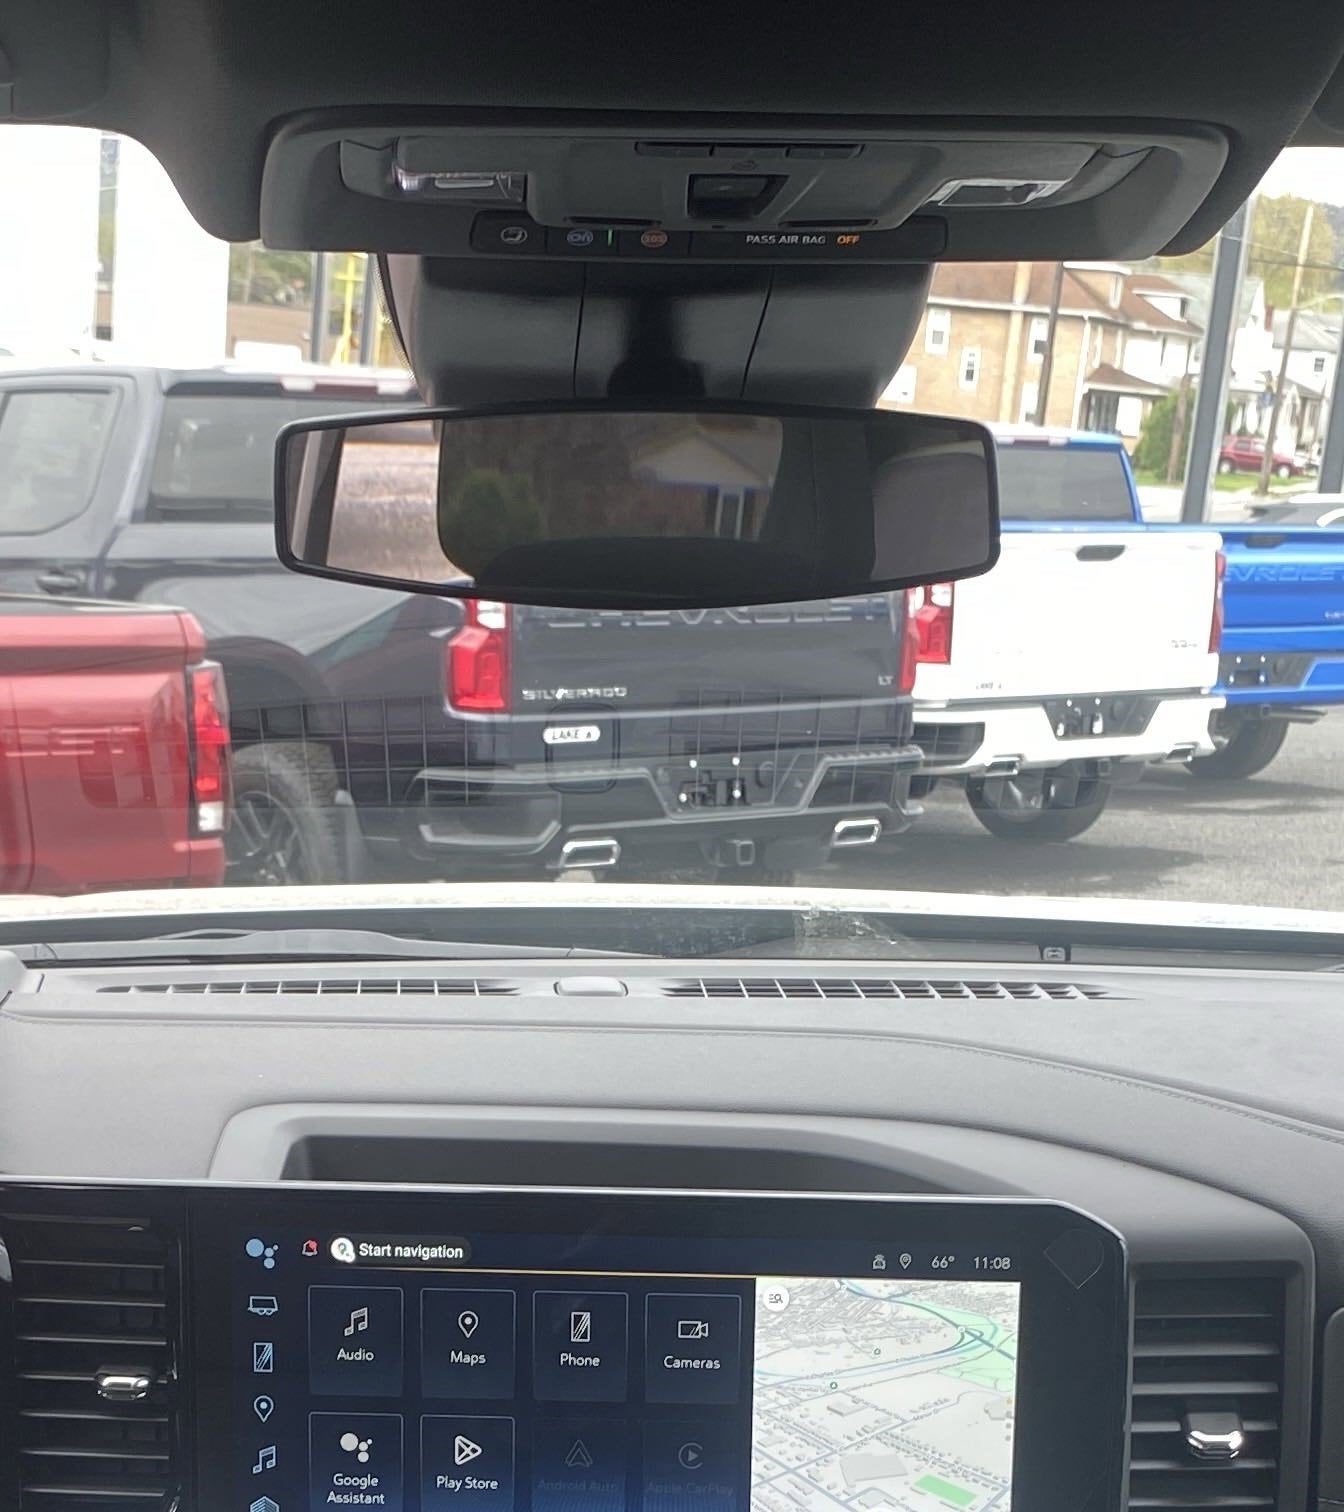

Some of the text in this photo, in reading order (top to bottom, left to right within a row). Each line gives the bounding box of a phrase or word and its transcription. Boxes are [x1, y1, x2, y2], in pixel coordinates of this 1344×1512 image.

[746, 235, 859, 245] PASS AIR BAG OFF
[522, 687, 627, 700] SILVERADO
[359, 1243, 463, 1260] Start navigation
[931, 1255, 955, 1269] 66°
[973, 1256, 1011, 1270] 11:08
[336, 1348, 375, 1362] Audio
[450, 1350, 486, 1366] Maps
[560, 1352, 601, 1367] Phone
[663, 1356, 721, 1369] Cameras
[332, 1473, 379, 1490] Google
[436, 1475, 498, 1492] Play Store
[326, 1490, 385, 1505] Assistant
